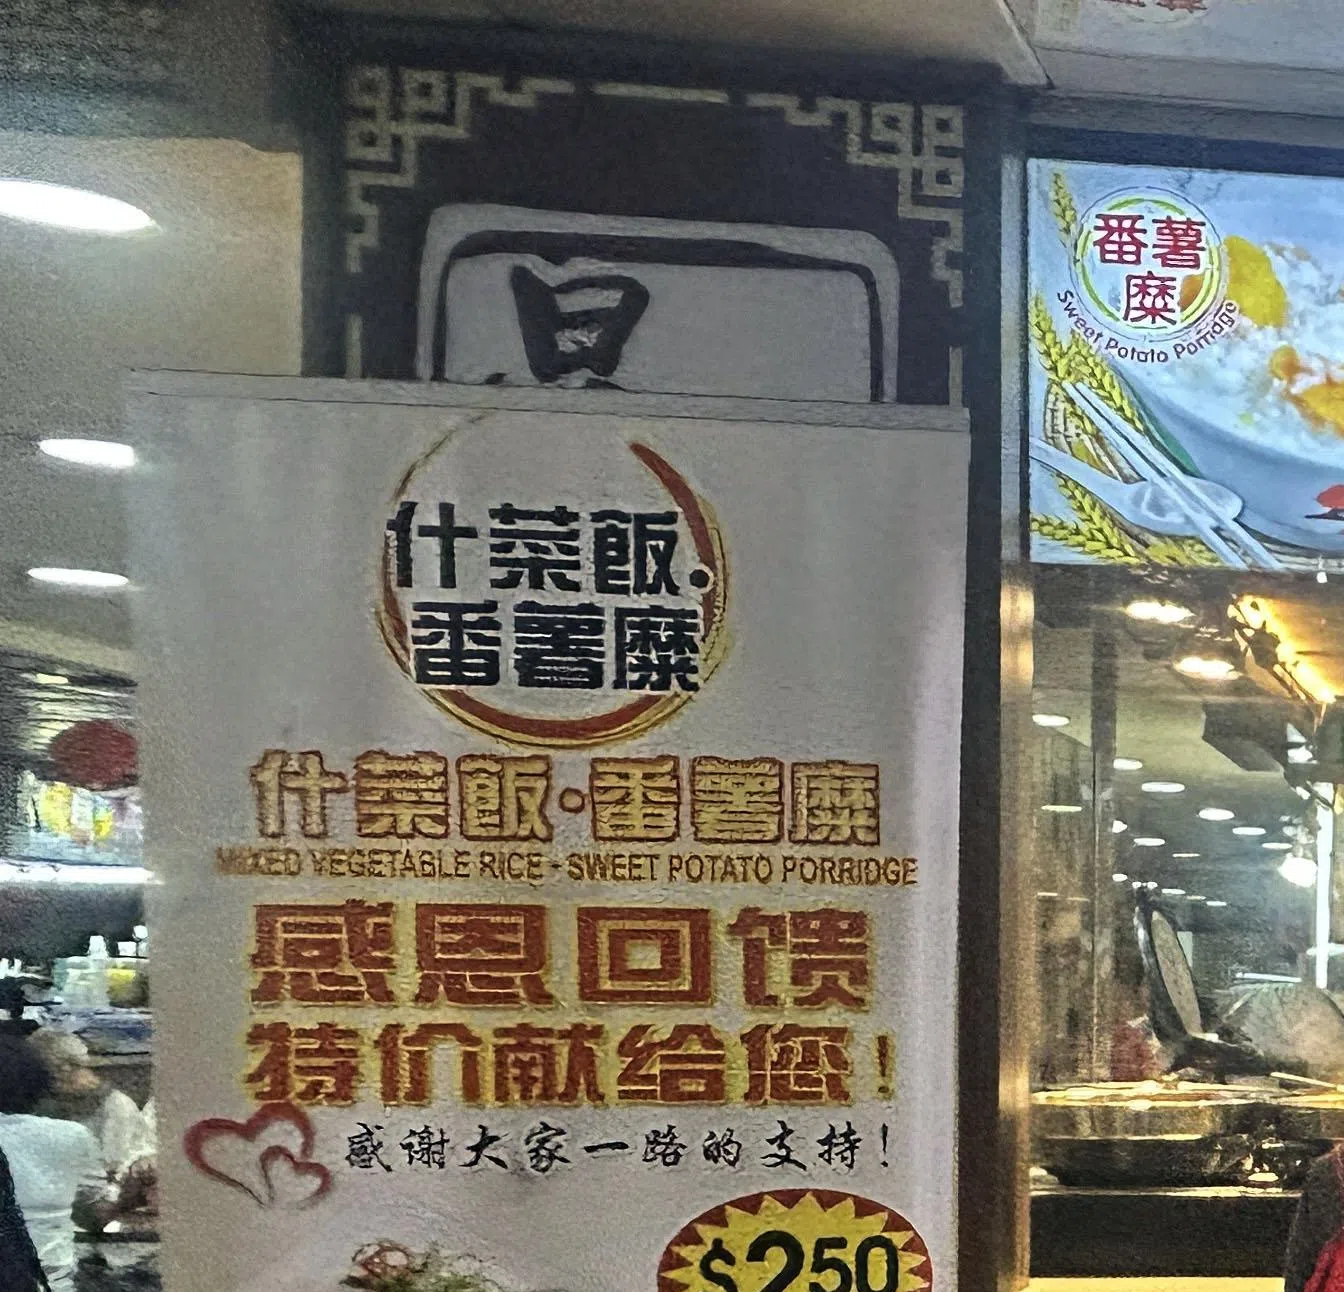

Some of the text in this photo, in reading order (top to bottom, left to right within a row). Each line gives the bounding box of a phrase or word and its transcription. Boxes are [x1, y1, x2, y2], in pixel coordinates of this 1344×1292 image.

[1093, 213, 1206, 270] 番薯
[1057, 289, 1104, 343] Sweet
[1106, 336, 1169, 363] Potato
[1123, 270, 1177, 325] 糜
[408, 598, 704, 694] 番薯糜
[311, 849, 471, 879] VEGETABLE
[479, 850, 545, 880] RICE
[567, 852, 660, 882] SWEET
[668, 854, 774, 884] POTATO
[781, 855, 920, 886] PORRIDGE
[250, 898, 878, 1008] 感恩回馈
